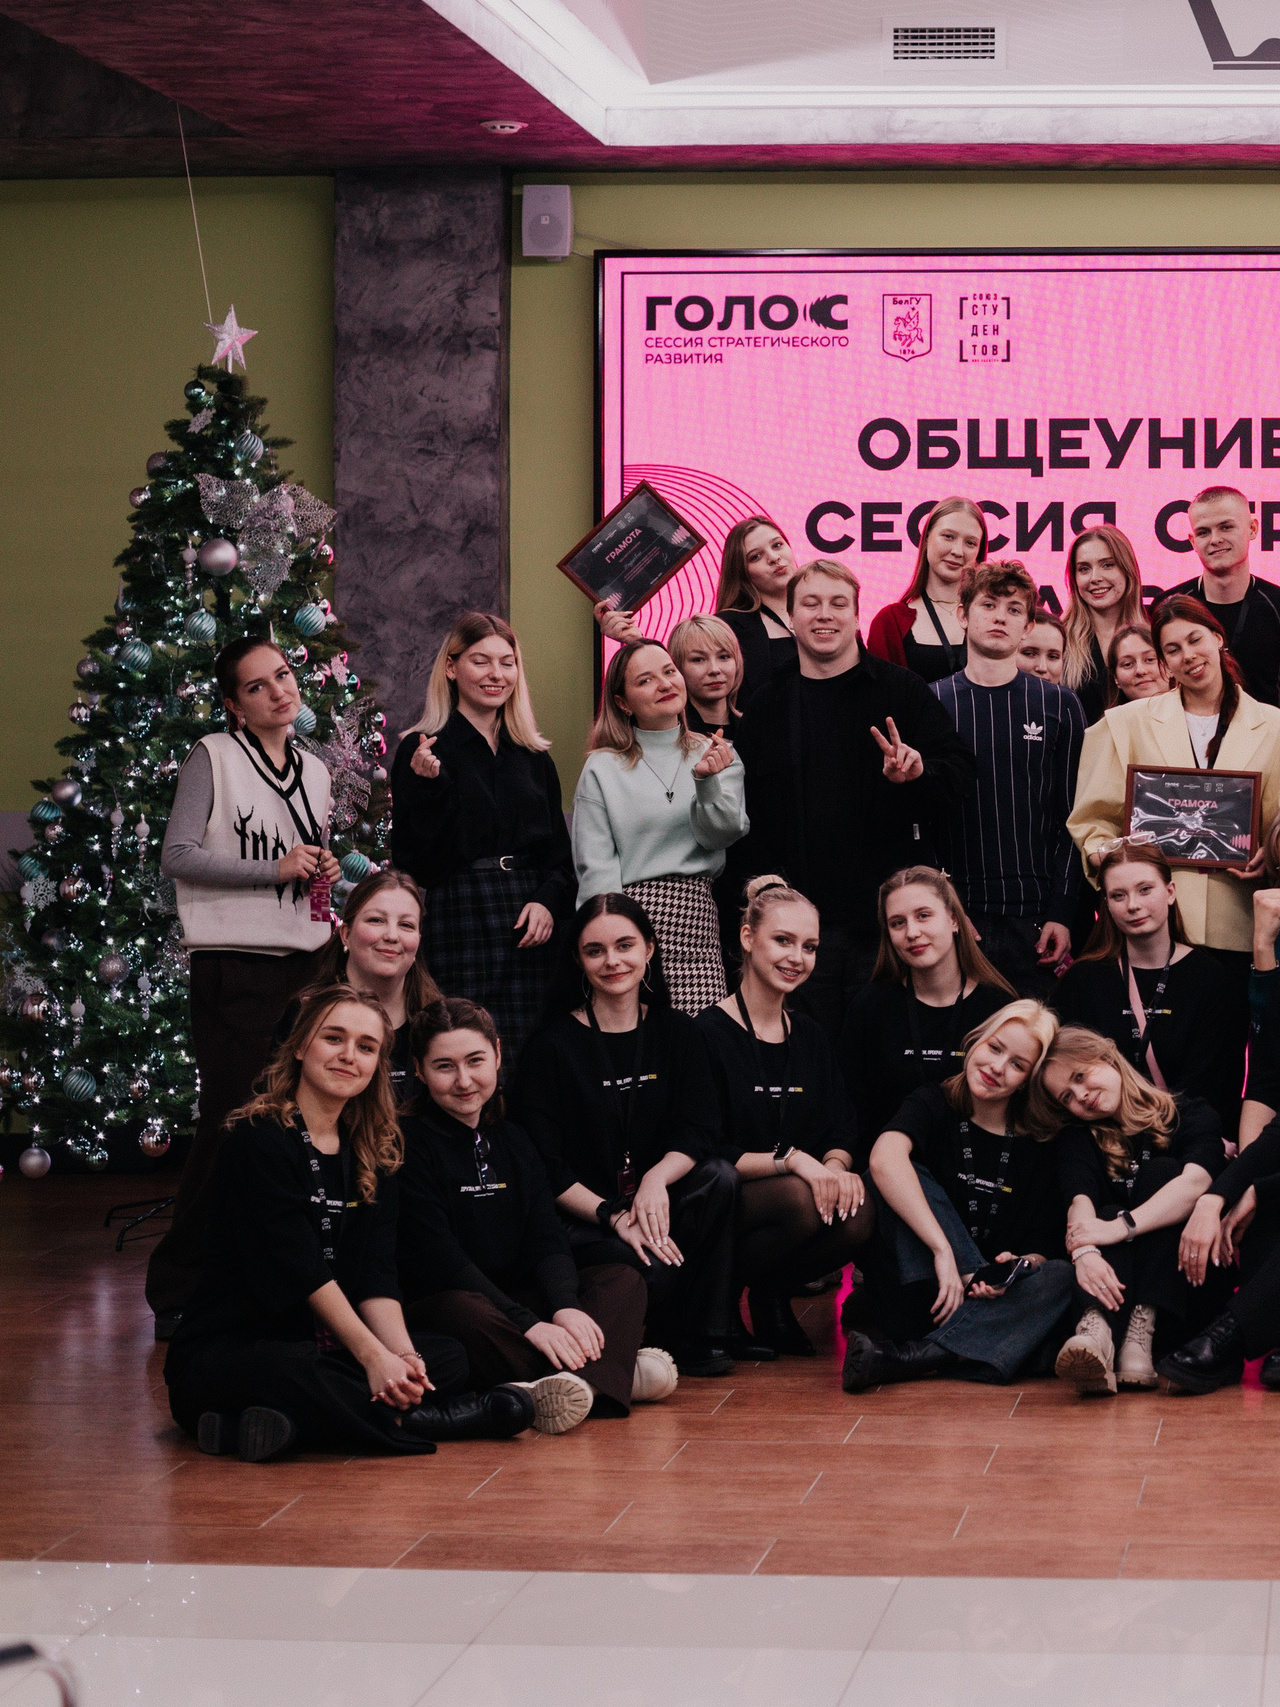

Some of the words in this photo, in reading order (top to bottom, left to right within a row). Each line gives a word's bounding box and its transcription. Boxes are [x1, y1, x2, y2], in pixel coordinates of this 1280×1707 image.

[645, 294, 848, 332] ГОЛОС
[971, 304, 999, 316] СТУ
[970, 325, 1000, 337] ДЕН
[645, 336, 703, 348] СЕССИЯ
[708, 335, 849, 348] СТРАТЕГИЧЕСКОГО
[971, 345, 999, 356] ТОВ
[645, 353, 724, 365] РАЗВИТИЯ
[604, 527, 643, 564] ГРАМОТА
[1167, 798, 1218, 809] ГРАМОТА
